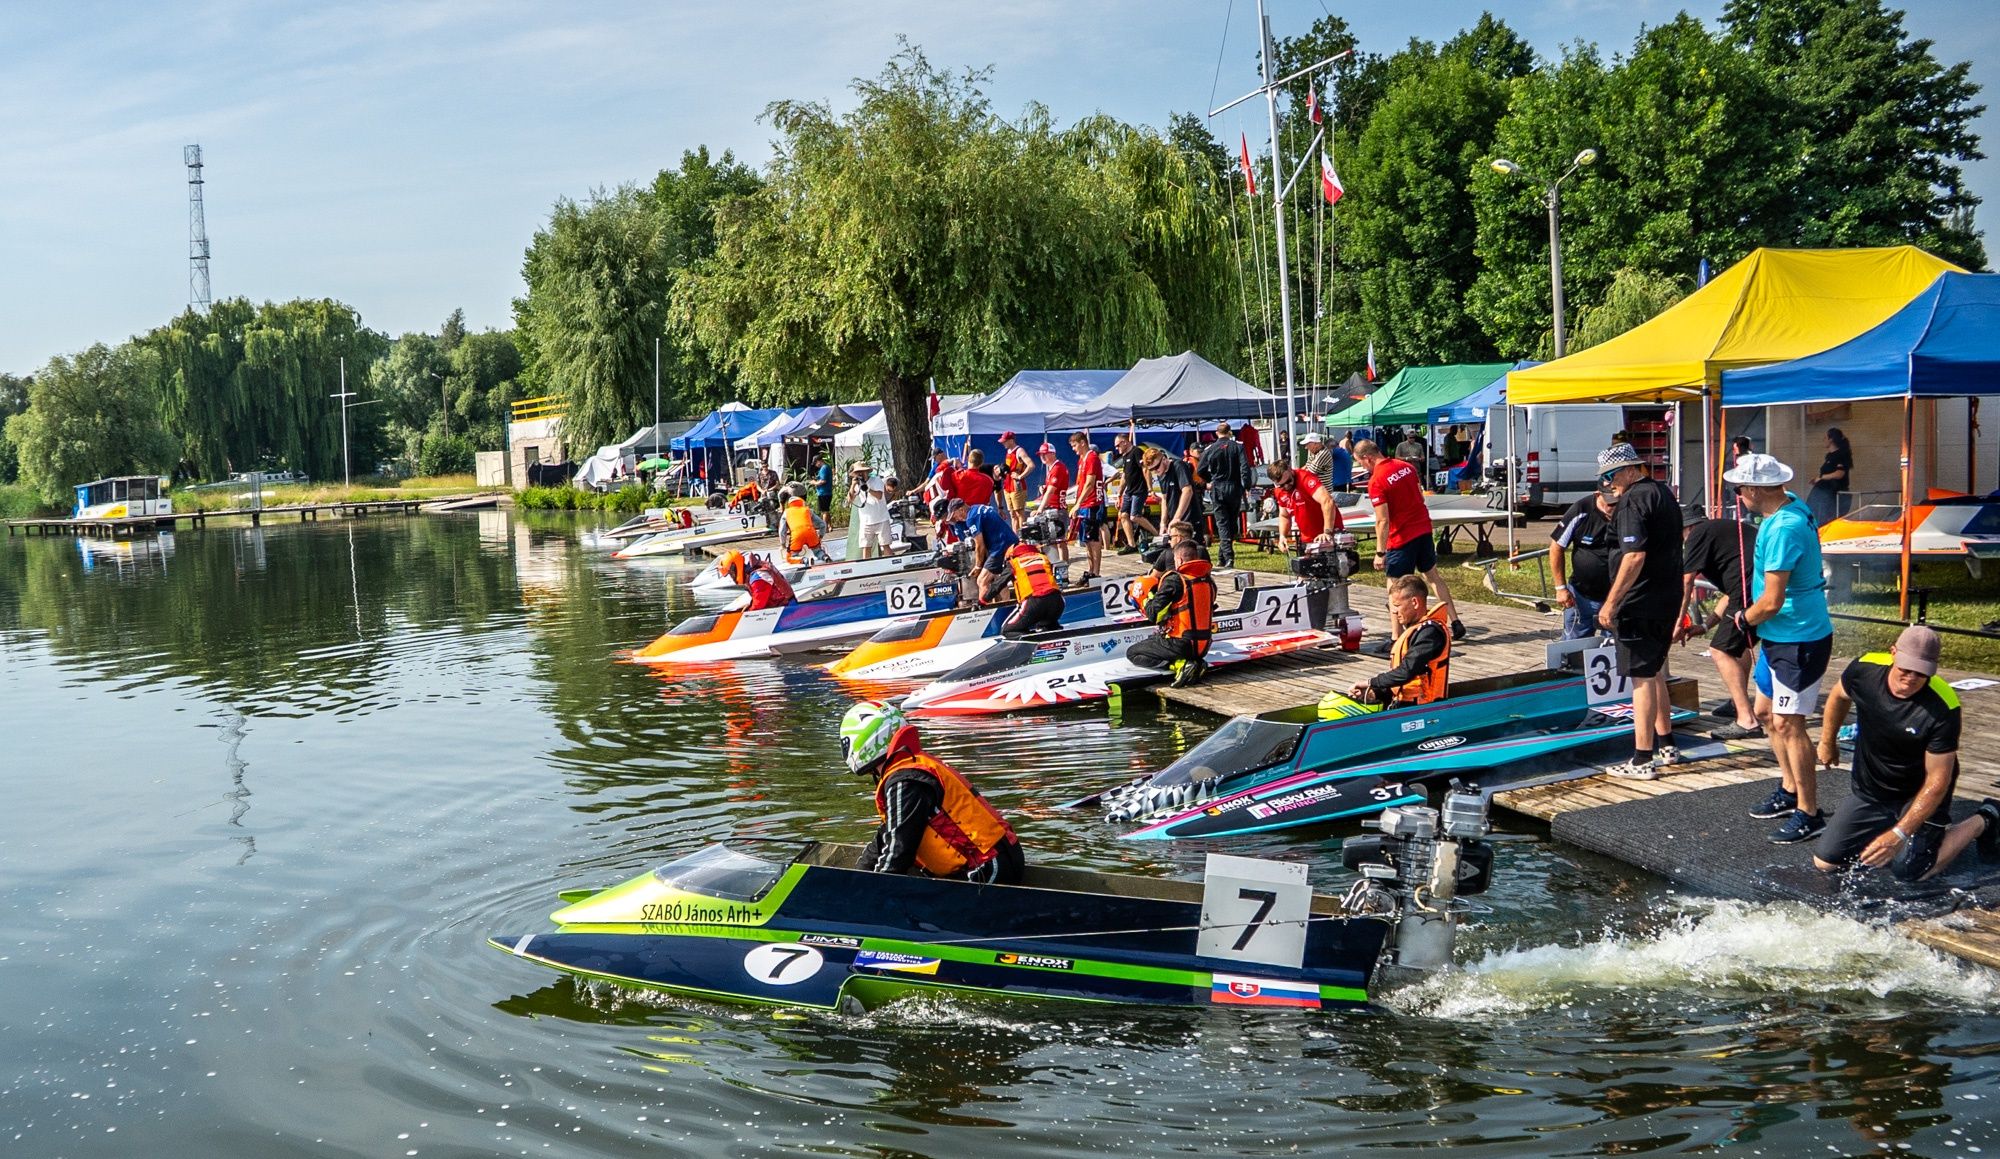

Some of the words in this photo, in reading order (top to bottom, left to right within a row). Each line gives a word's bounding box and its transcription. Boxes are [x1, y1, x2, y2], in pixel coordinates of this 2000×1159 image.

[1387, 466, 1412, 485] POLSKA
[1487, 490, 1503, 511] 22
[741, 516, 756, 529] 97
[891, 585, 922, 610] 62
[1266, 594, 1301, 626] 24
[1047, 673, 1087, 689] 24
[1778, 696, 1791, 707] 97
[1422, 736, 1460, 749] LIFELINE
[1369, 783, 1404, 801] 37
[1276, 798, 1318, 813] PAVING
[641, 900, 683, 921] SZABÓ
[684, 904, 723, 922] János
[727, 905, 763, 923] Arh+
[1232, 888, 1277, 951] 7
[768, 947, 810, 979] 7
